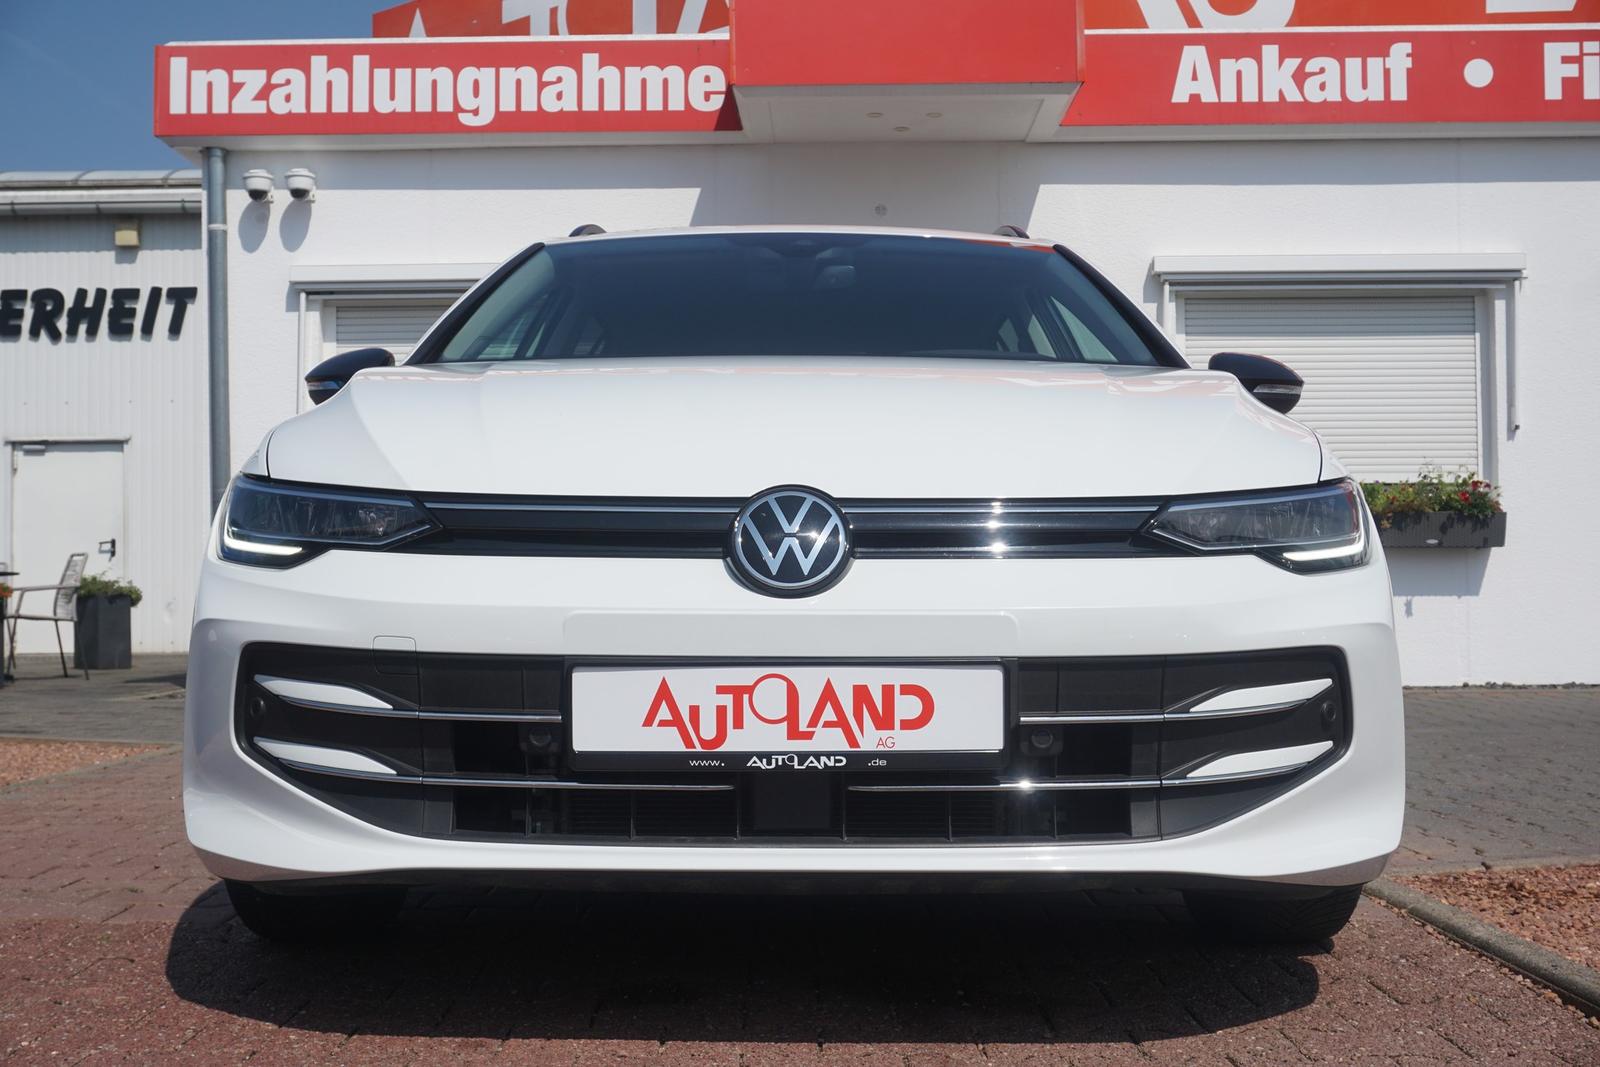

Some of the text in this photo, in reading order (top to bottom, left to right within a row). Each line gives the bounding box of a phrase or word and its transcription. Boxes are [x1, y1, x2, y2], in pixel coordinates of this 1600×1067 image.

[168, 52, 727, 127] Inzahlungnahme
[1171, 41, 1600, 103] Ankauf Fi
[0, 286, 198, 345] ERHEIT
[737, 493, 843, 585] VW
[641, 673, 935, 751] AUTOLAND
[876, 736, 896, 749] AG
[689, 753, 887, 770] www. AUTOLAND .de
